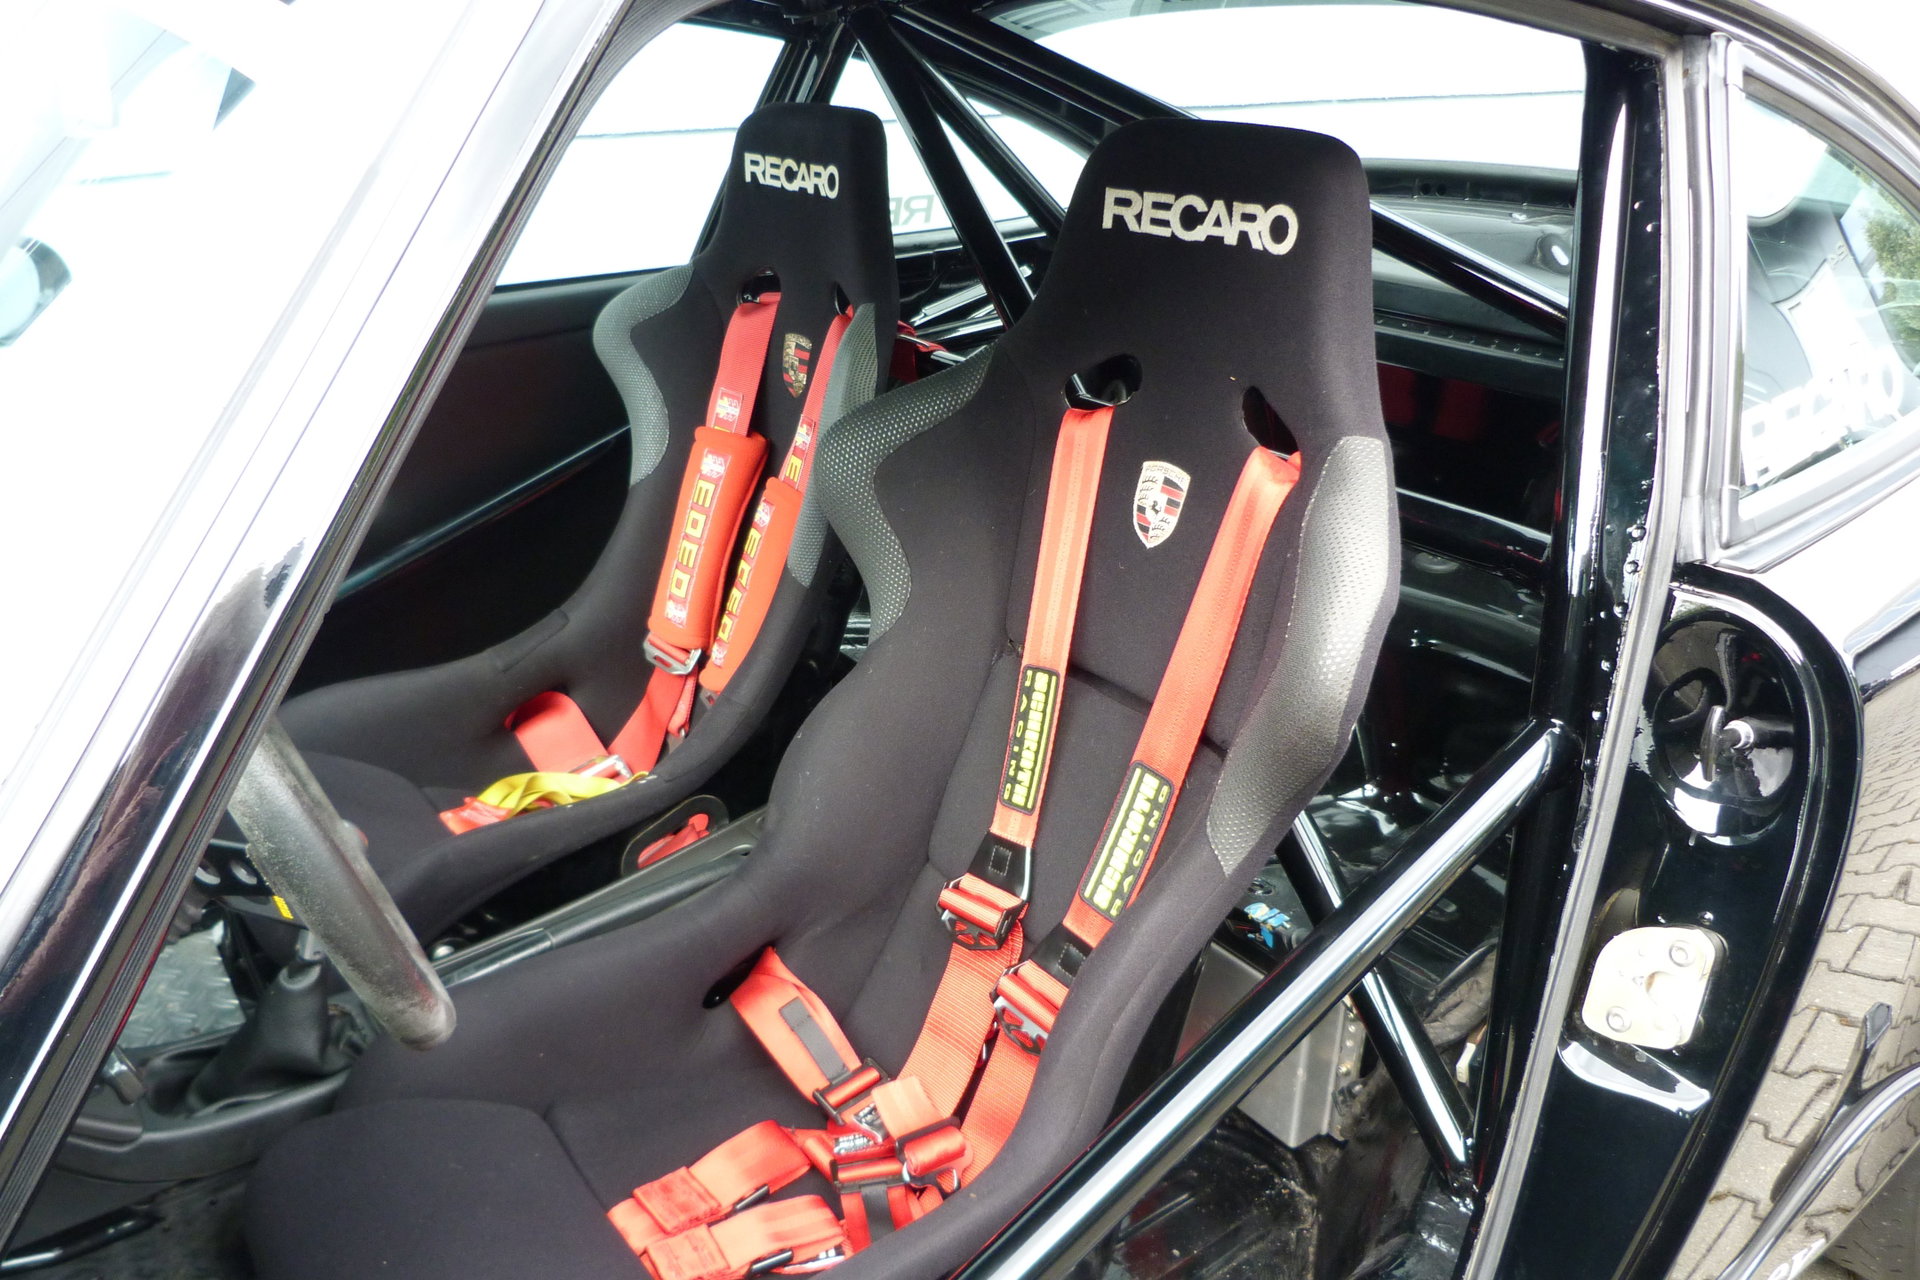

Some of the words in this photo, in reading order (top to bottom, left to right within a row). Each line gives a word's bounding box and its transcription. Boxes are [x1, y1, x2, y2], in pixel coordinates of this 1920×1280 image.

[744, 152, 840, 199] RECARO
[1102, 187, 1299, 255] RECARO
[1003, 669, 1033, 801] RACING
[1011, 671, 1049, 807] SCHROTH
[1092, 771, 1161, 911] SCHROTH
[1110, 784, 1170, 918] RACING
